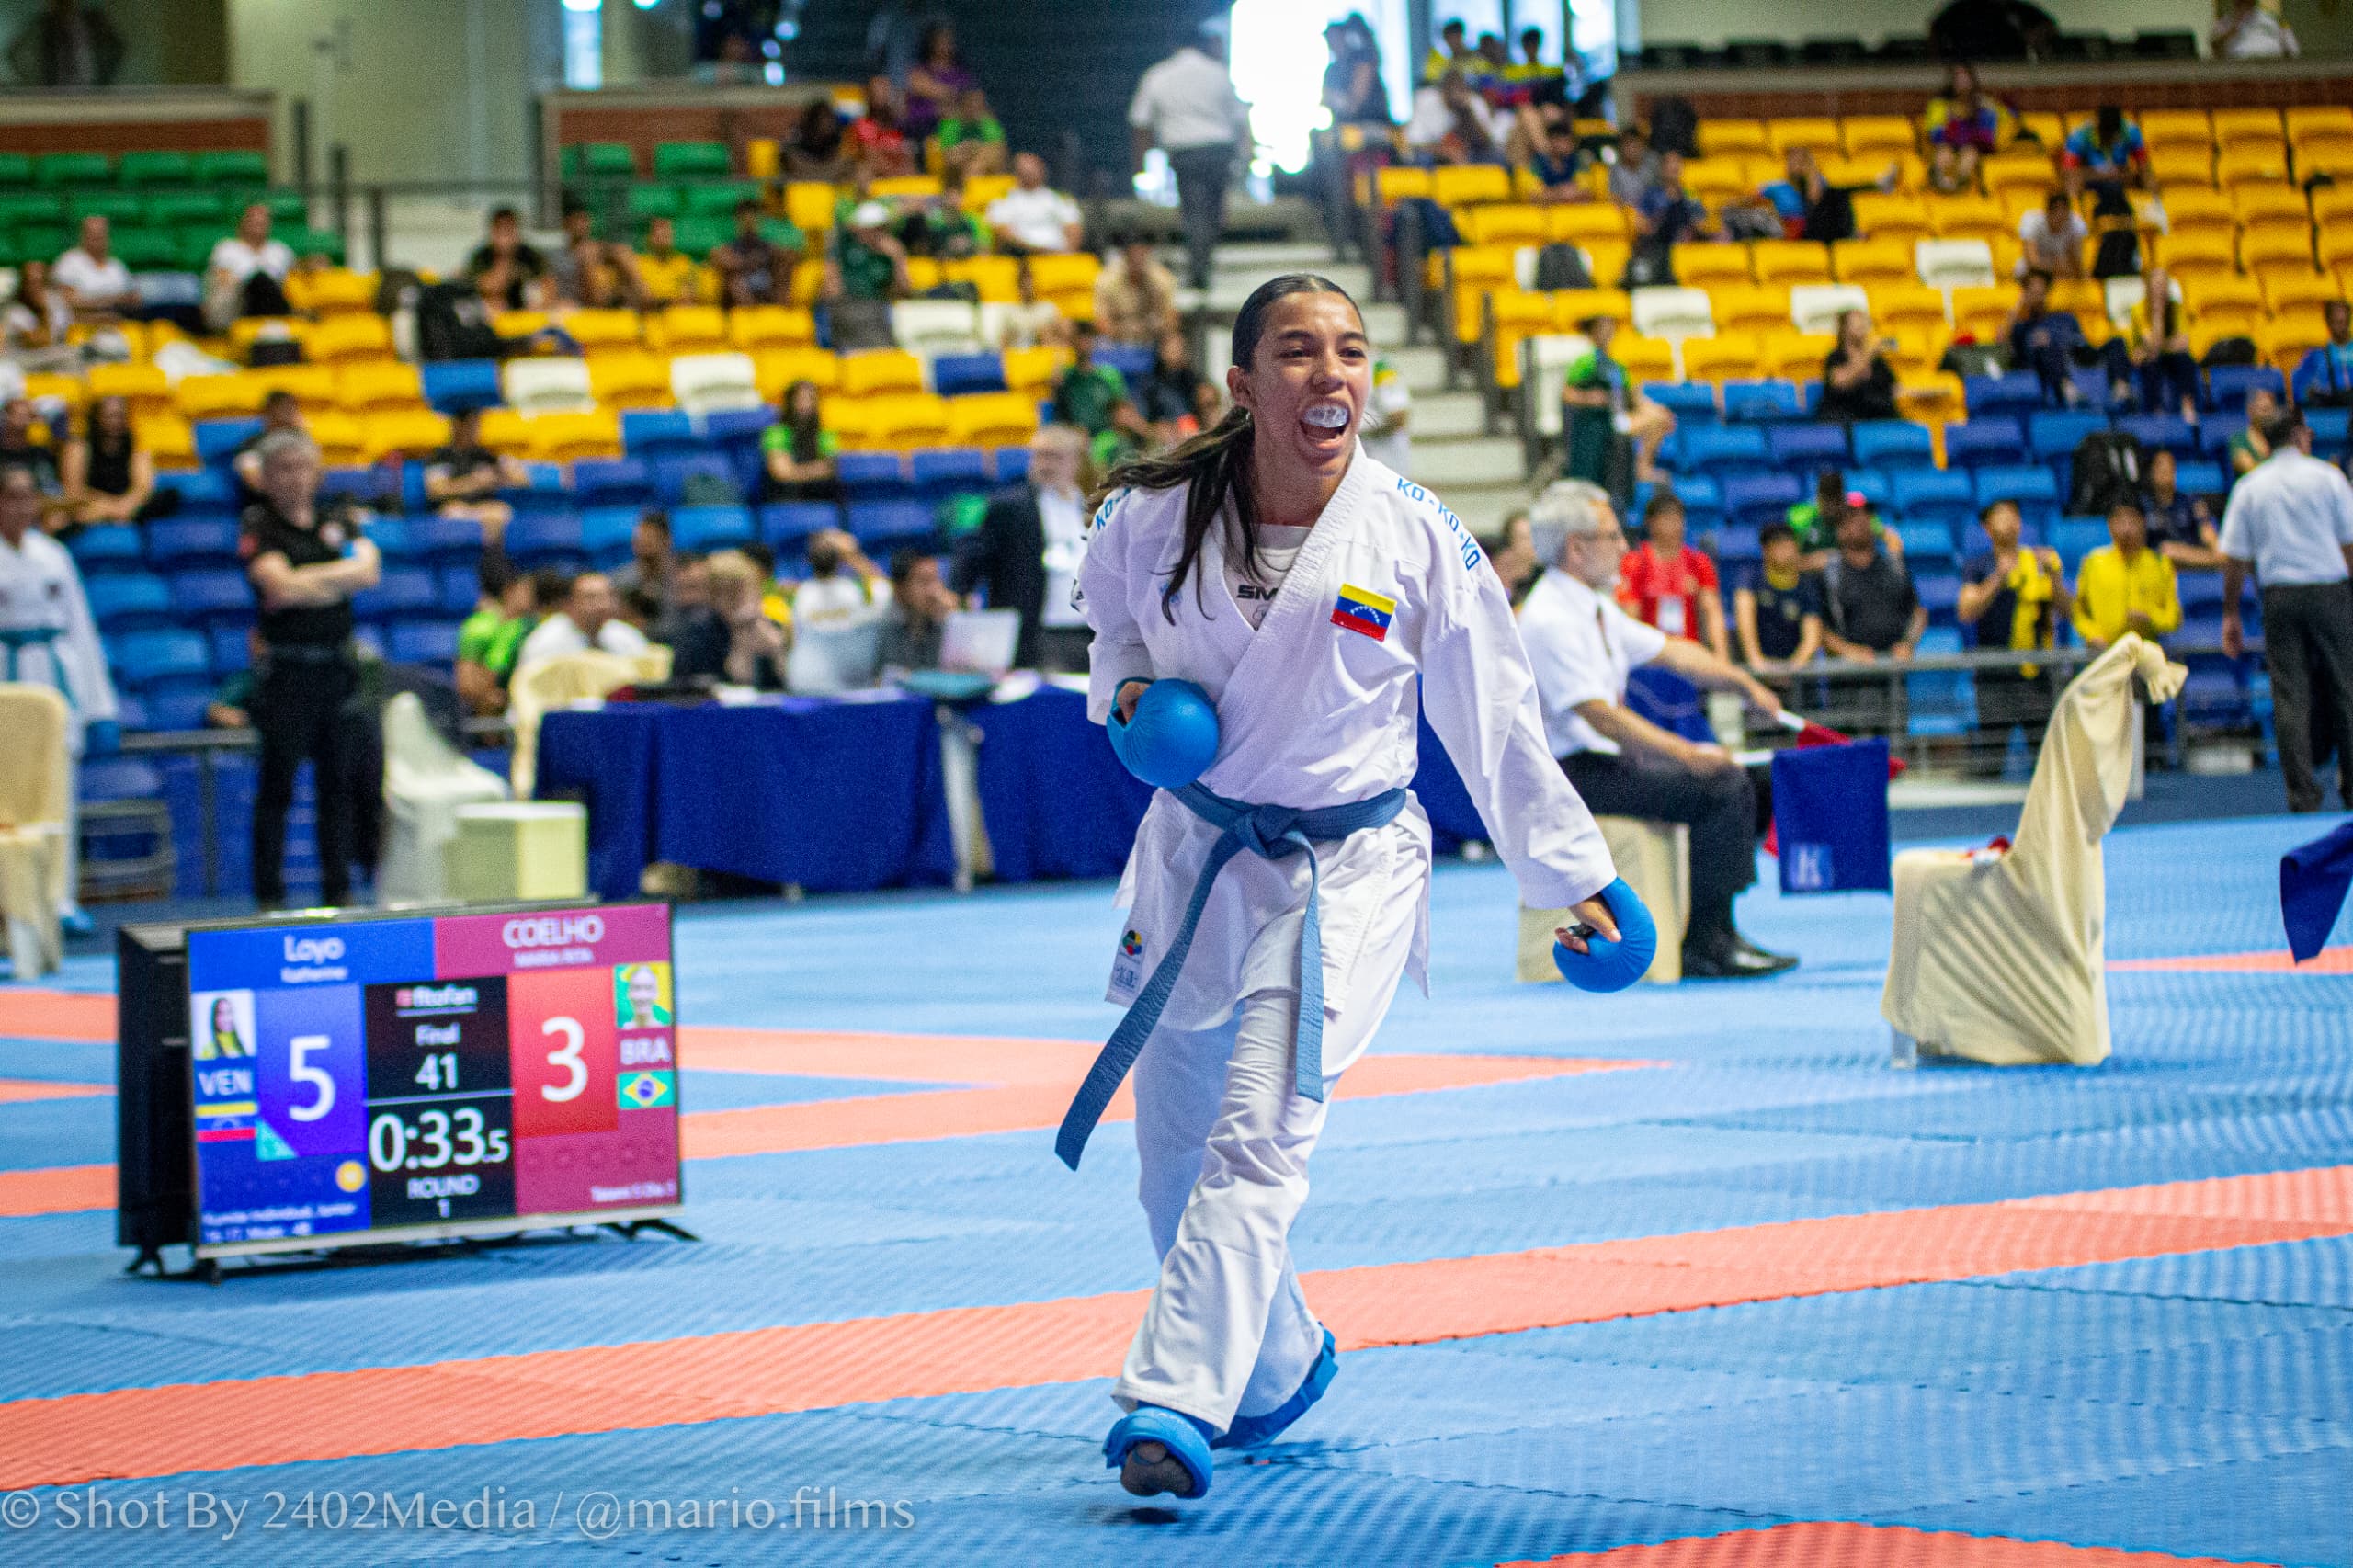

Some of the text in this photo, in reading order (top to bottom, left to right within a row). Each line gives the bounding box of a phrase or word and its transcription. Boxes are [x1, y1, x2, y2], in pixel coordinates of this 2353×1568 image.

[503, 915, 604, 948] COELHO
[284, 934, 346, 965] Loyo
[415, 1022, 461, 1046] Final
[542, 1016, 588, 1102] 3
[620, 1037, 673, 1065] BRA
[198, 1068, 253, 1096] VEN
[289, 1034, 336, 1122] 5
[415, 1052, 459, 1091] 41
[407, 1174, 481, 1199] ROUND
[437, 1198, 450, 1218] 1
